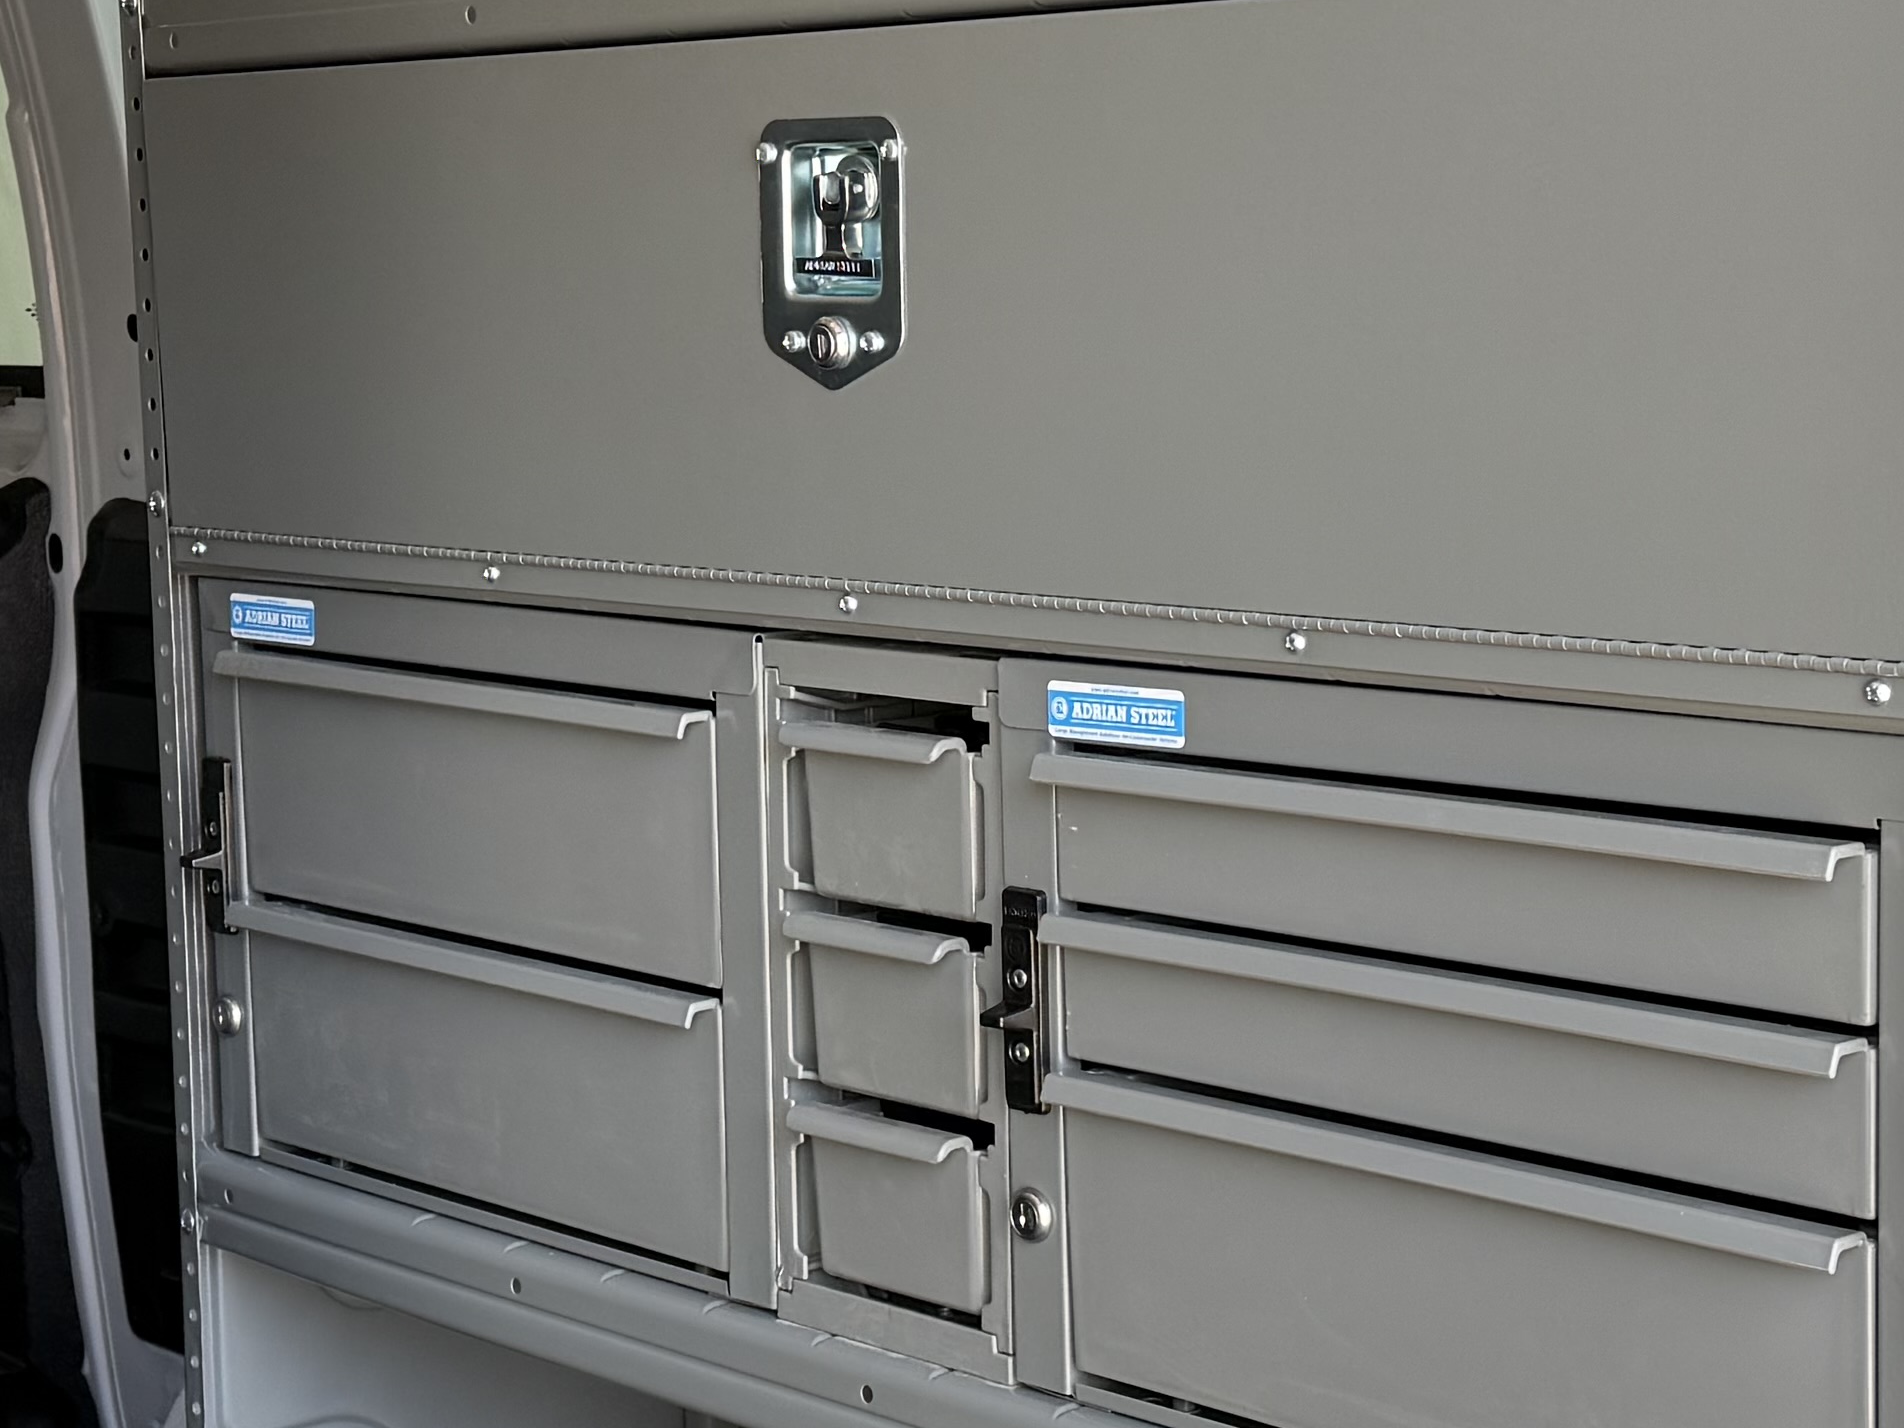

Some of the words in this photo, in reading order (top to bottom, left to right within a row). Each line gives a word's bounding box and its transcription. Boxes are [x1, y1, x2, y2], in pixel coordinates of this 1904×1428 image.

[245, 609, 279, 627] ADRIAN
[281, 613, 310, 629] STEEL
[1072, 701, 1127, 723] ADRIAN
[1130, 707, 1176, 727] STEEL
